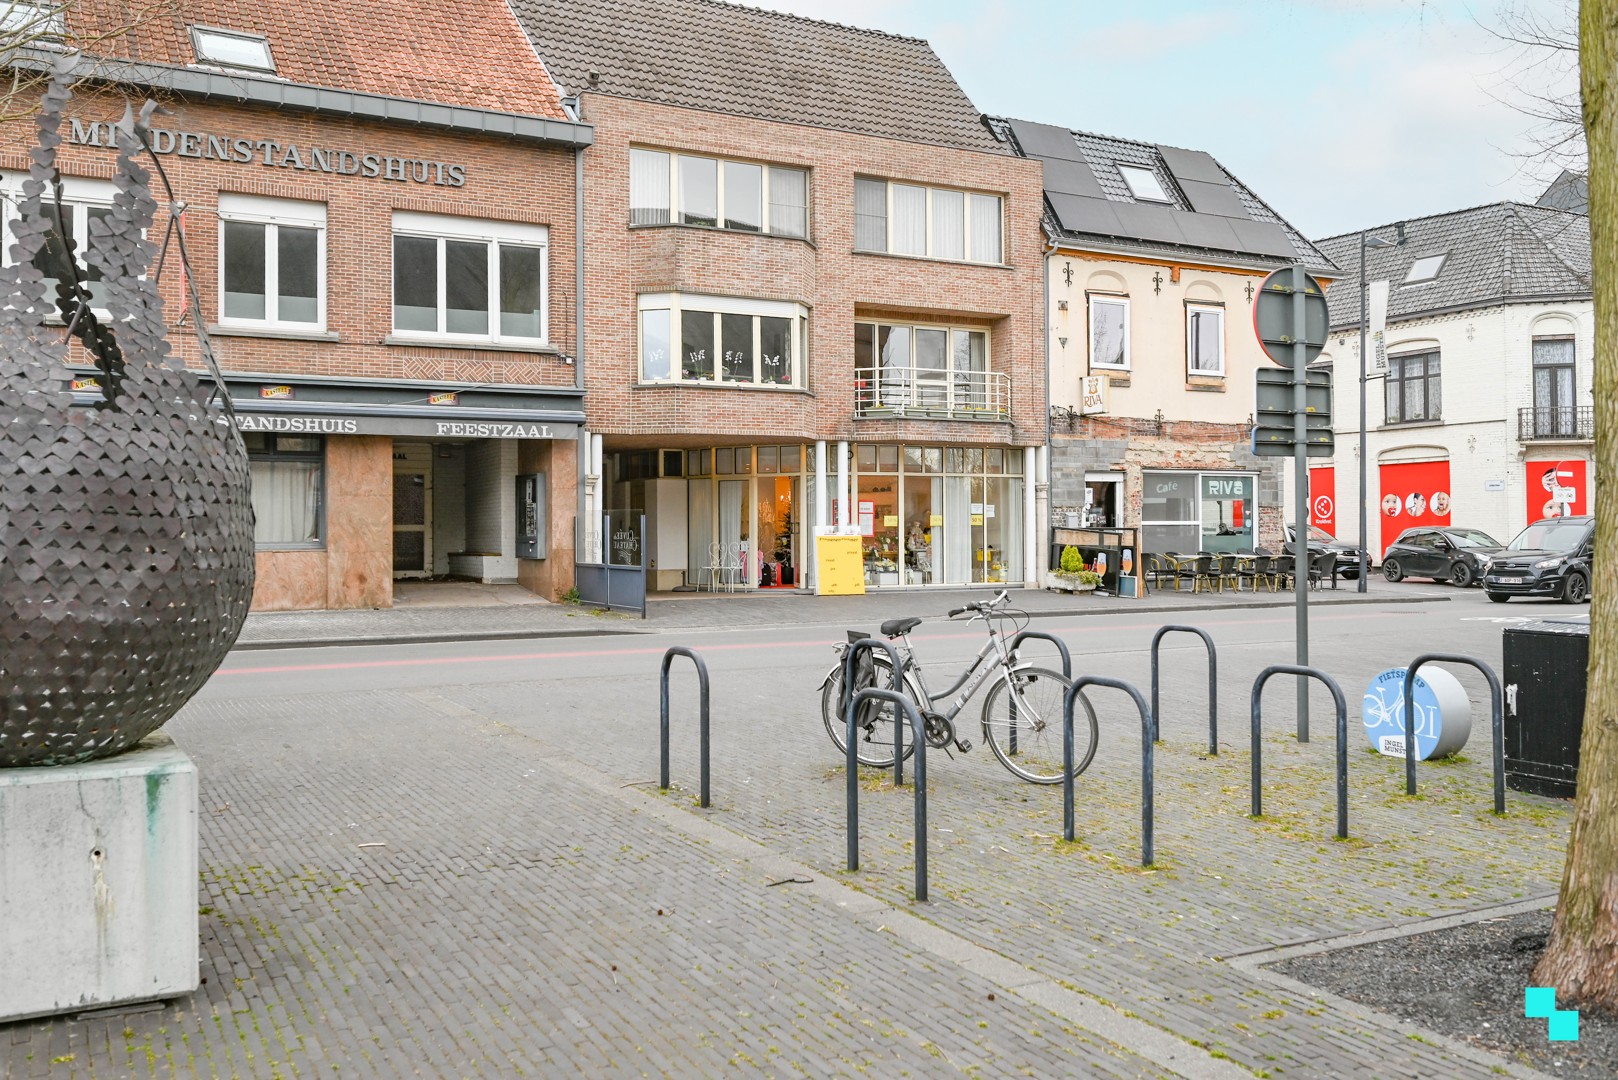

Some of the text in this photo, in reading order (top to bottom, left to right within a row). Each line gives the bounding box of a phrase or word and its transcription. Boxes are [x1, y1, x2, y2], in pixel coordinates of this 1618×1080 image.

[69, 118, 466, 187] MIDENSTANDSHUIS
[1084, 395, 1103, 407] RIVA
[208, 414, 357, 433] STANDSHUIS
[436, 422, 553, 438] FEESTZAAL
[393, 452, 408, 460] AAL
[1156, 480, 1179, 494] Café
[1378, 670, 1426, 689] FIETSPMP
[1384, 739, 1404, 749] INGEL
[1384, 746, 1407, 755] MUNST
